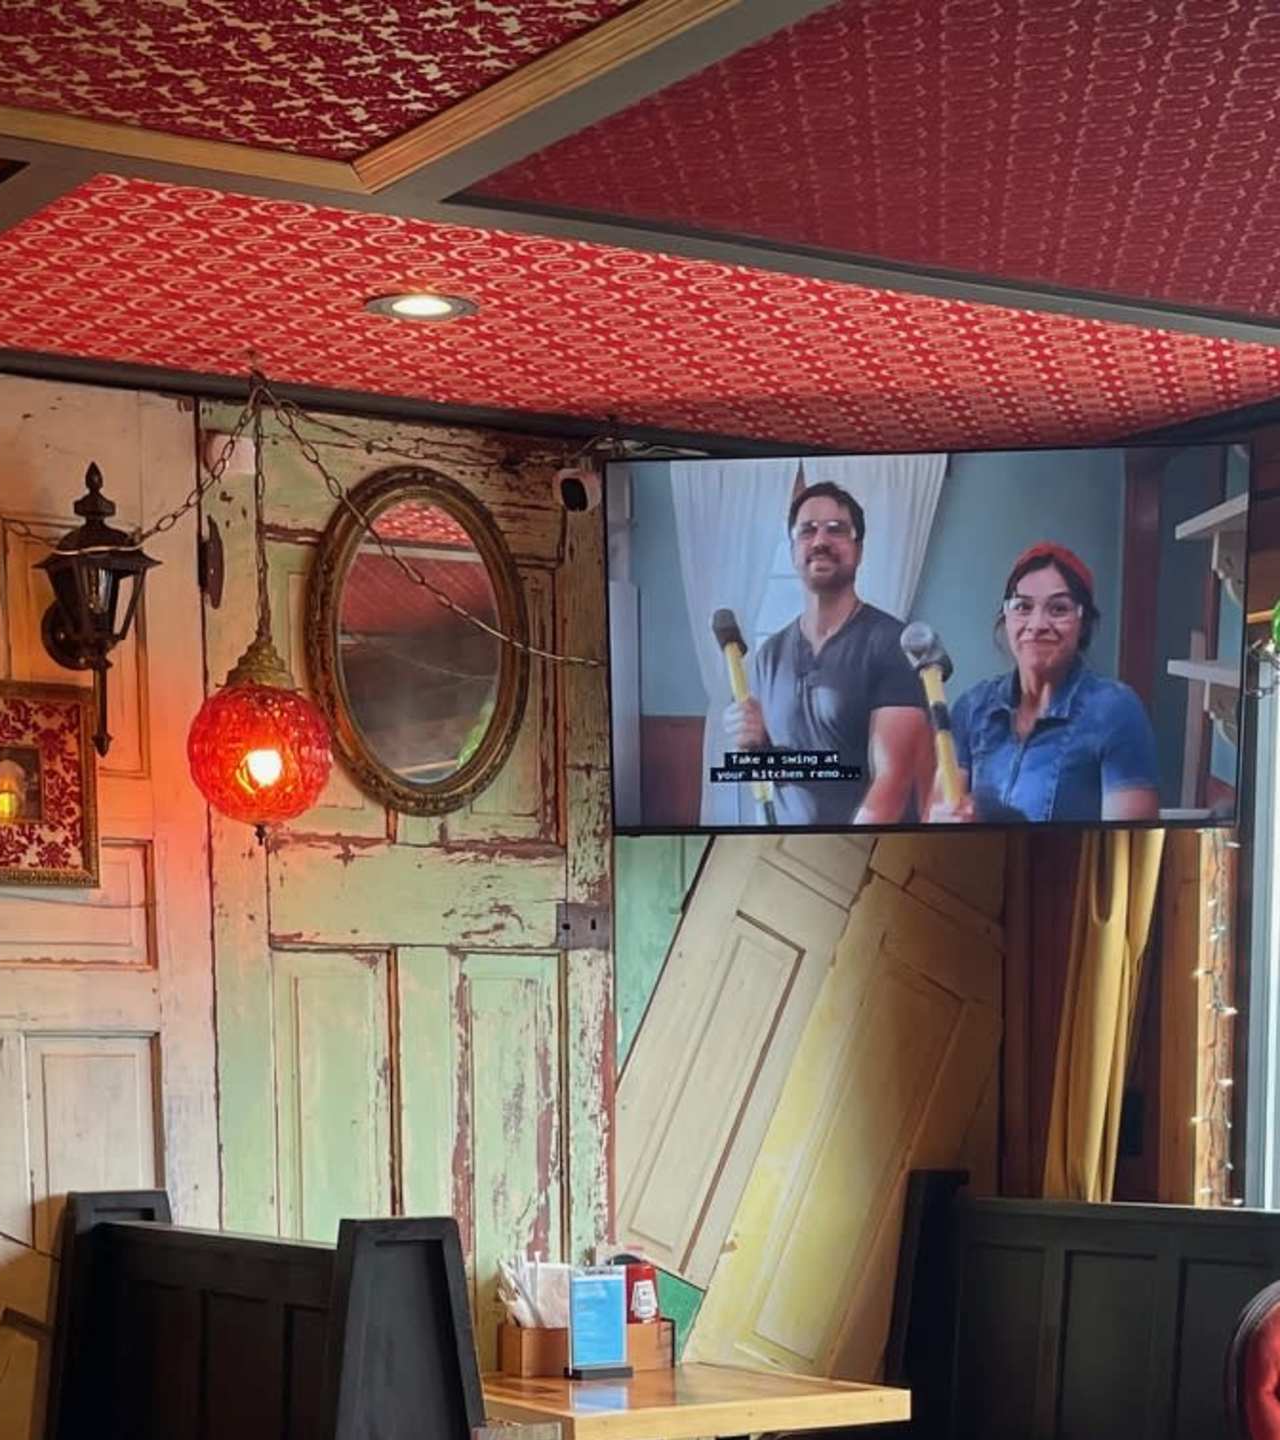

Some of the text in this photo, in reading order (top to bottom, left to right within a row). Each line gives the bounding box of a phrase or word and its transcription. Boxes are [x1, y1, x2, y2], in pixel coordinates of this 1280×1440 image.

[731, 754, 761, 765] Take
[781, 754, 819, 766] swing
[824, 754, 839, 764] at
[716, 768, 861, 781] your kitchen reno...
